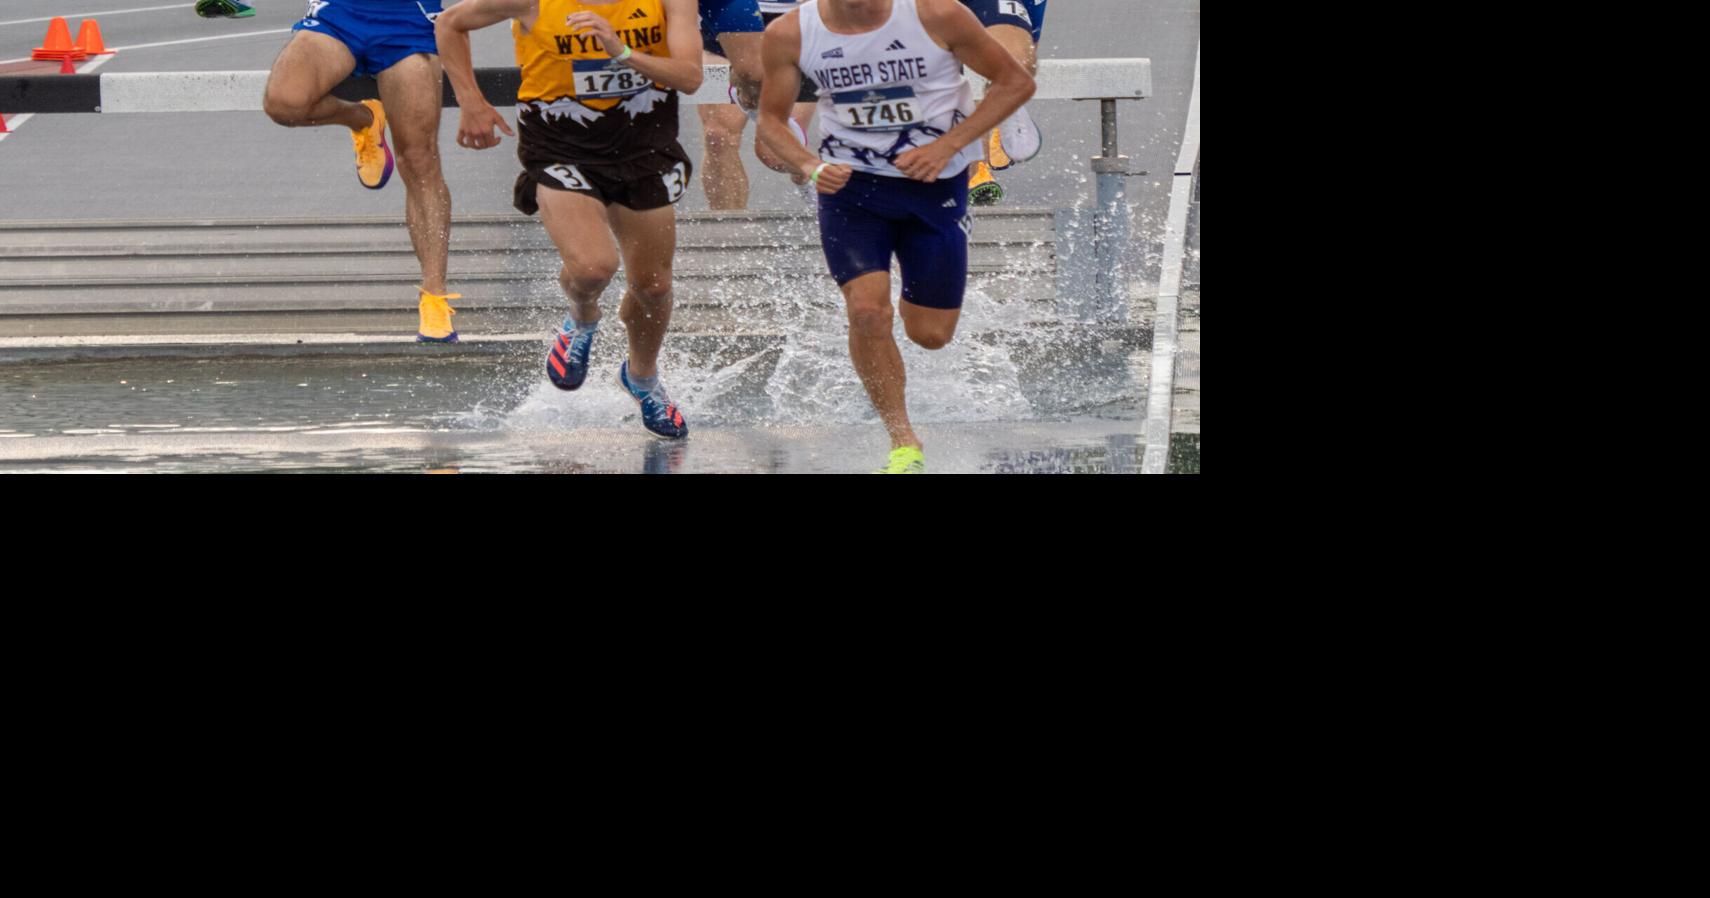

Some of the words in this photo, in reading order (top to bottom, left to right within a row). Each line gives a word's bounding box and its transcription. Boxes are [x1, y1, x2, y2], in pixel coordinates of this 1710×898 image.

[815, 63, 874, 89] WEBER
[878, 57, 927, 82] STATE
[848, 102, 913, 126] 1746
[554, 166, 583, 188] 3
[668, 167, 683, 198] 3
